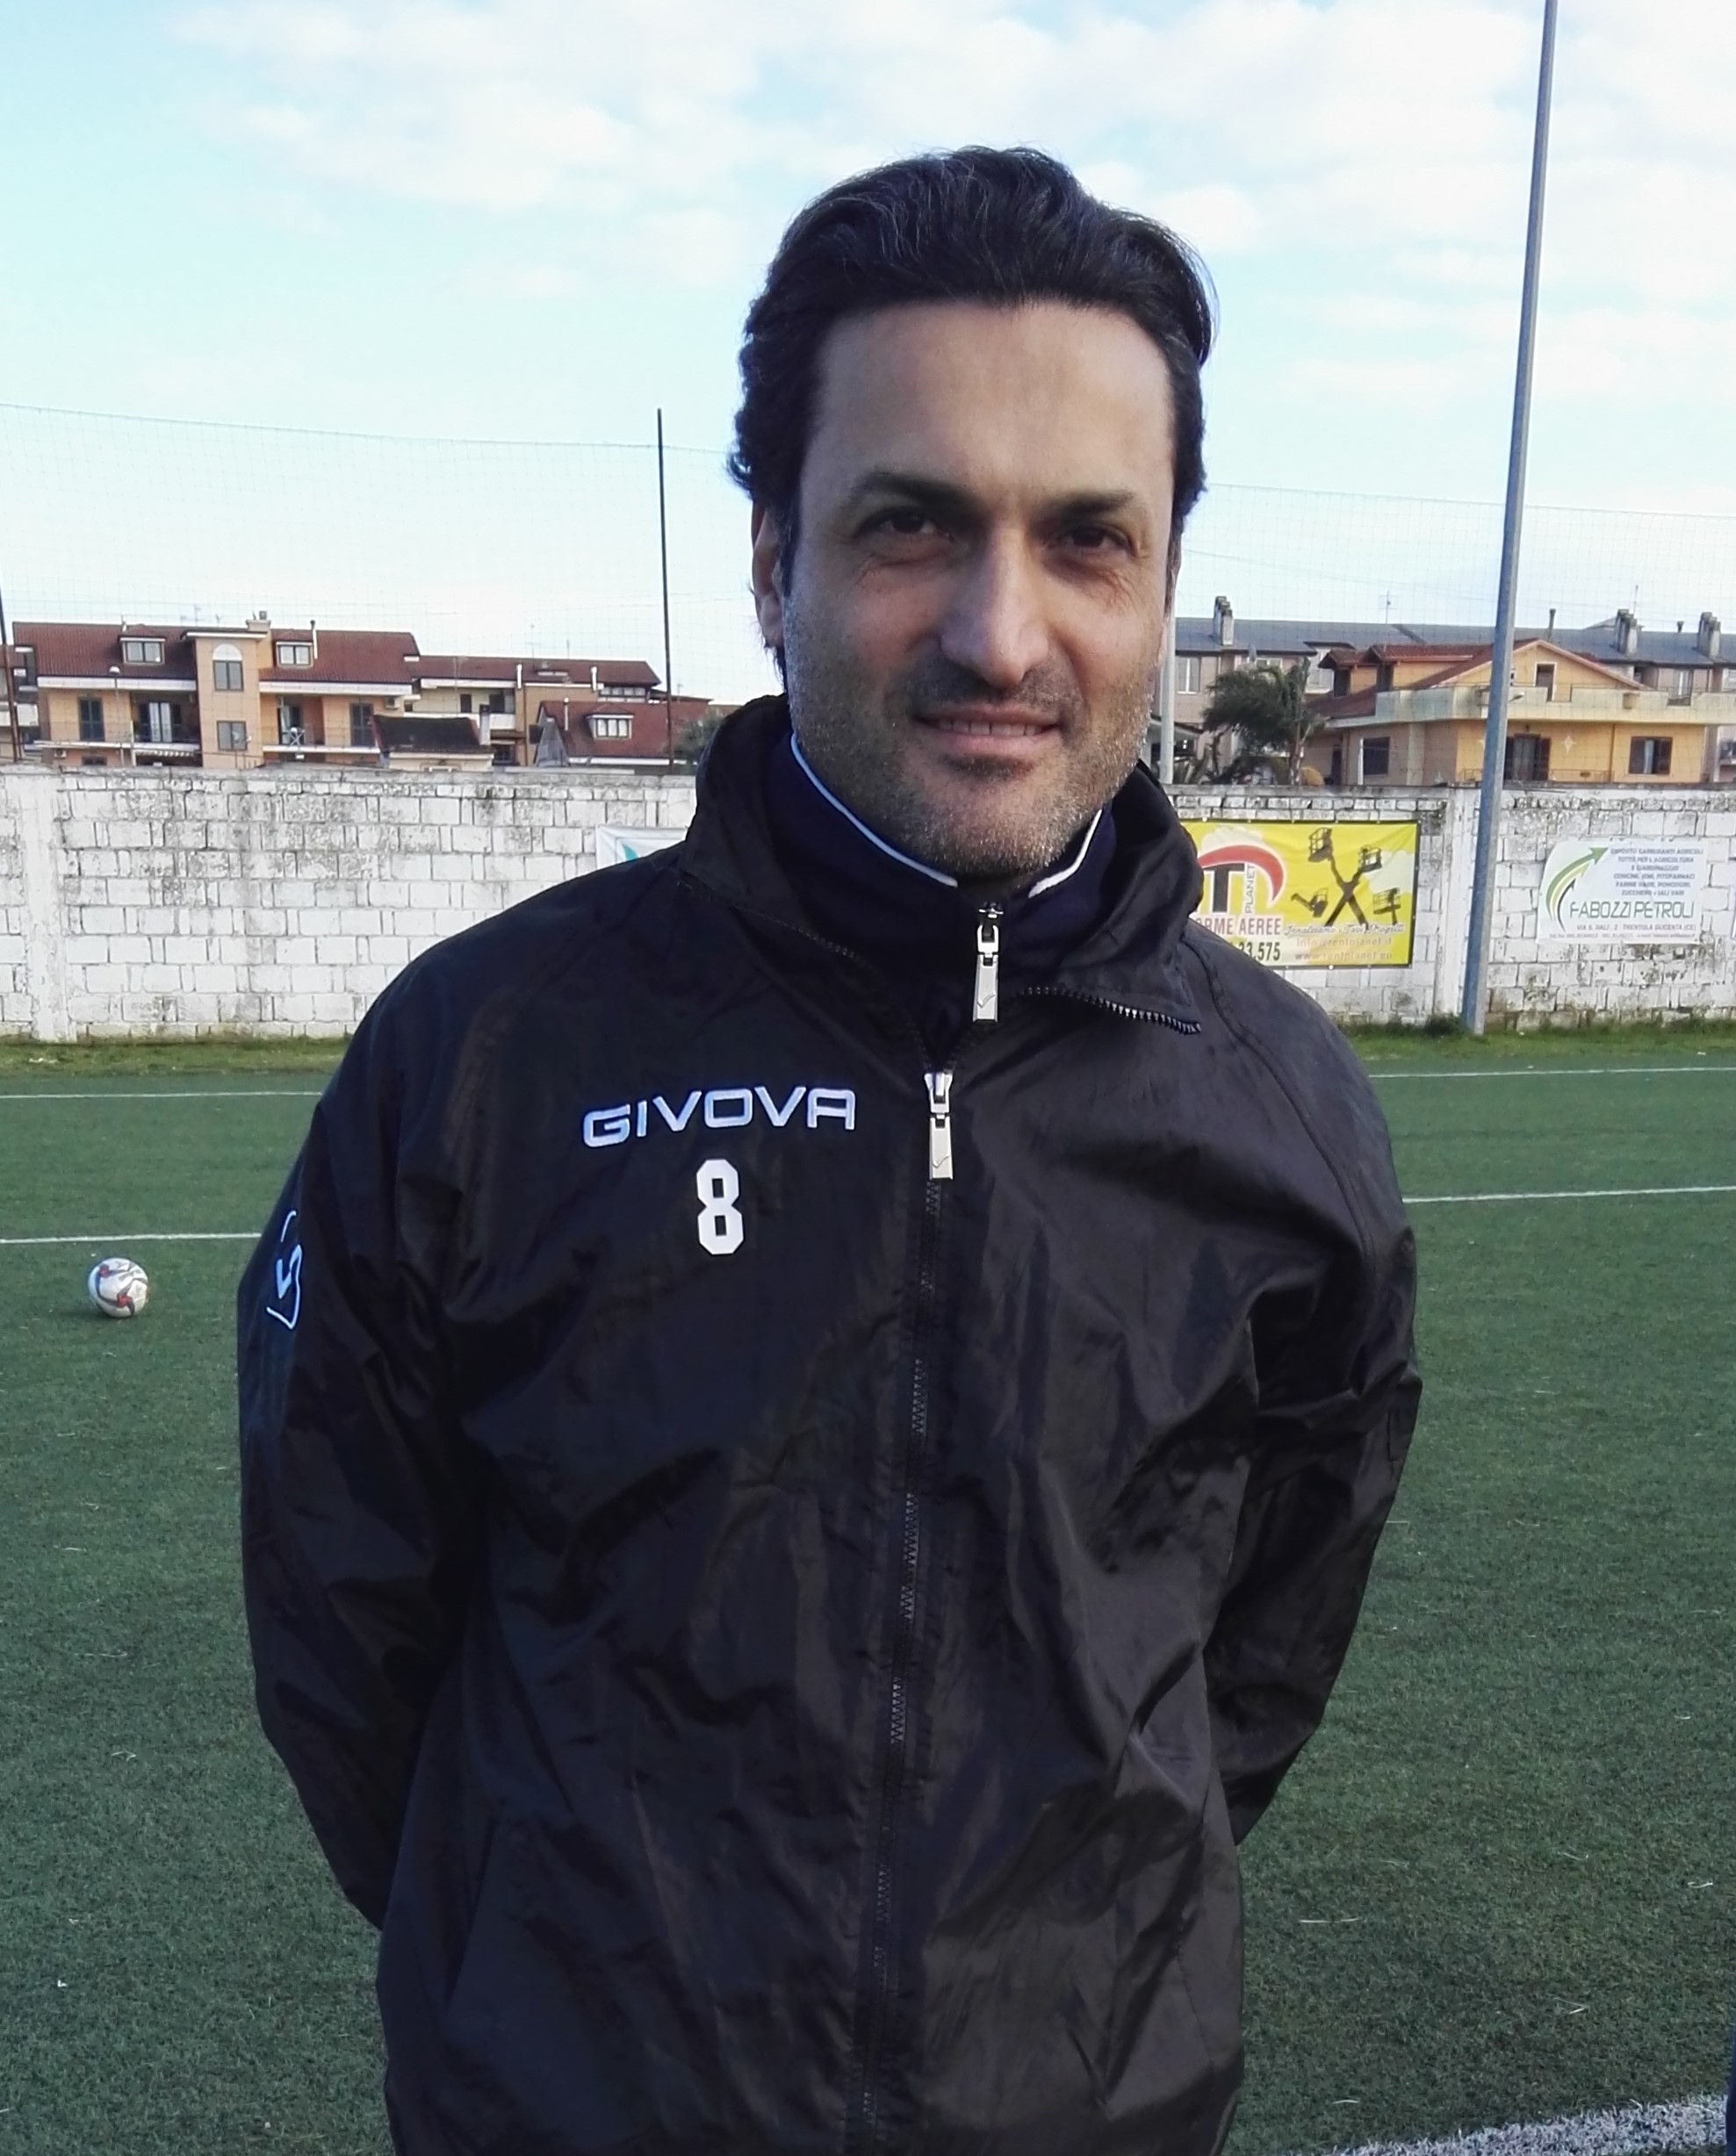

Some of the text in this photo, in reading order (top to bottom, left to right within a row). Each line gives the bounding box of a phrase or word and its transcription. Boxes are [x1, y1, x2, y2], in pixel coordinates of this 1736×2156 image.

[1245, 865, 1256, 914] PLANET
[1570, 901, 1695, 918] FABOZZI PETROLI
[1238, 917, 1281, 935] AEREE
[582, 1086, 856, 1147] GIVOVA
[695, 1159, 745, 1255] 8
